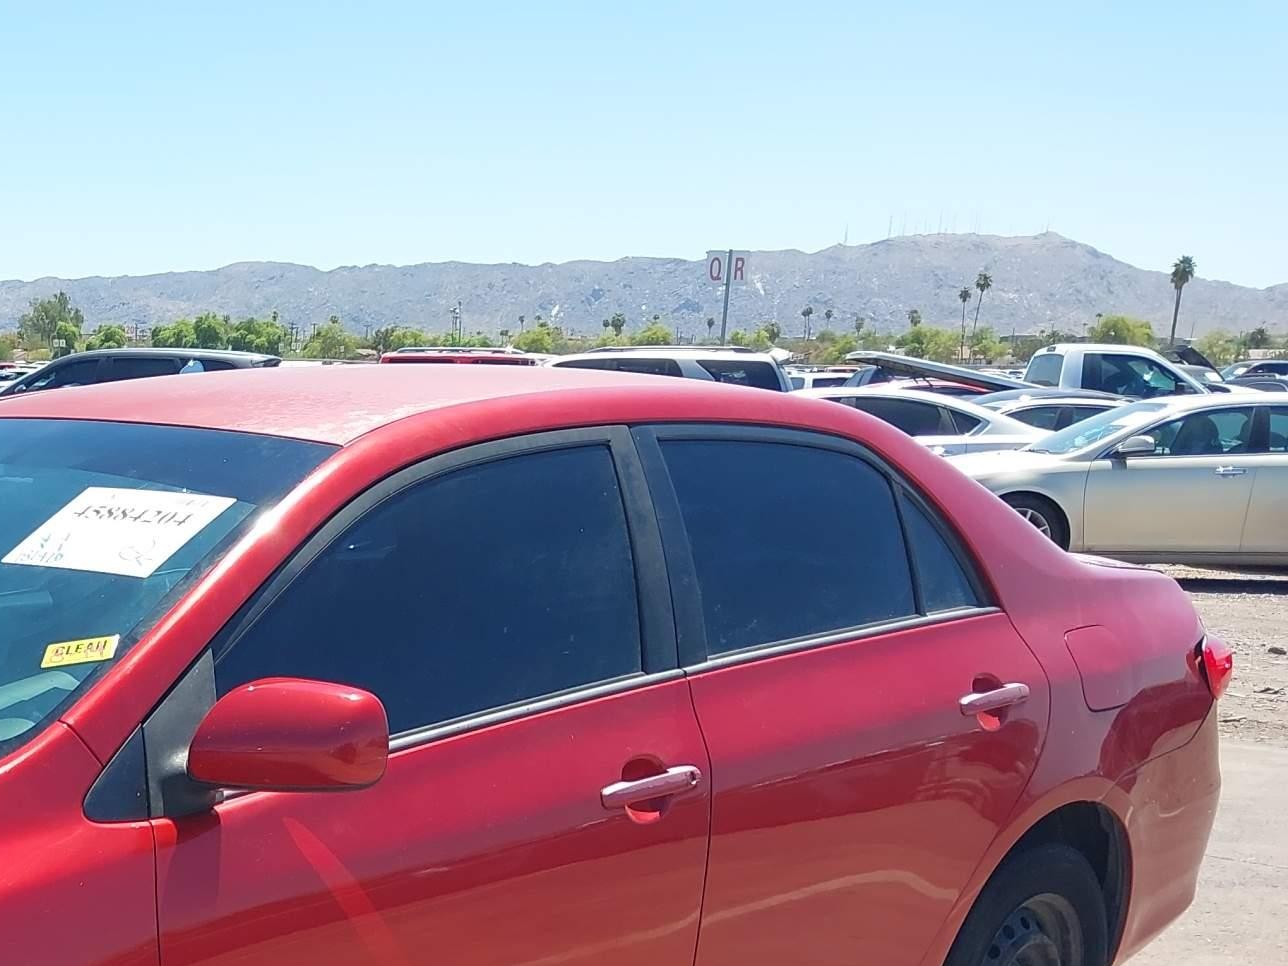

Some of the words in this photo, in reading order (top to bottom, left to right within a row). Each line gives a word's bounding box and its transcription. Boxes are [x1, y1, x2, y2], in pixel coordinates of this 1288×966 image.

[710, 257, 722, 281] Q
[734, 257, 745, 281] R
[73, 505, 194, 526] 45884204
